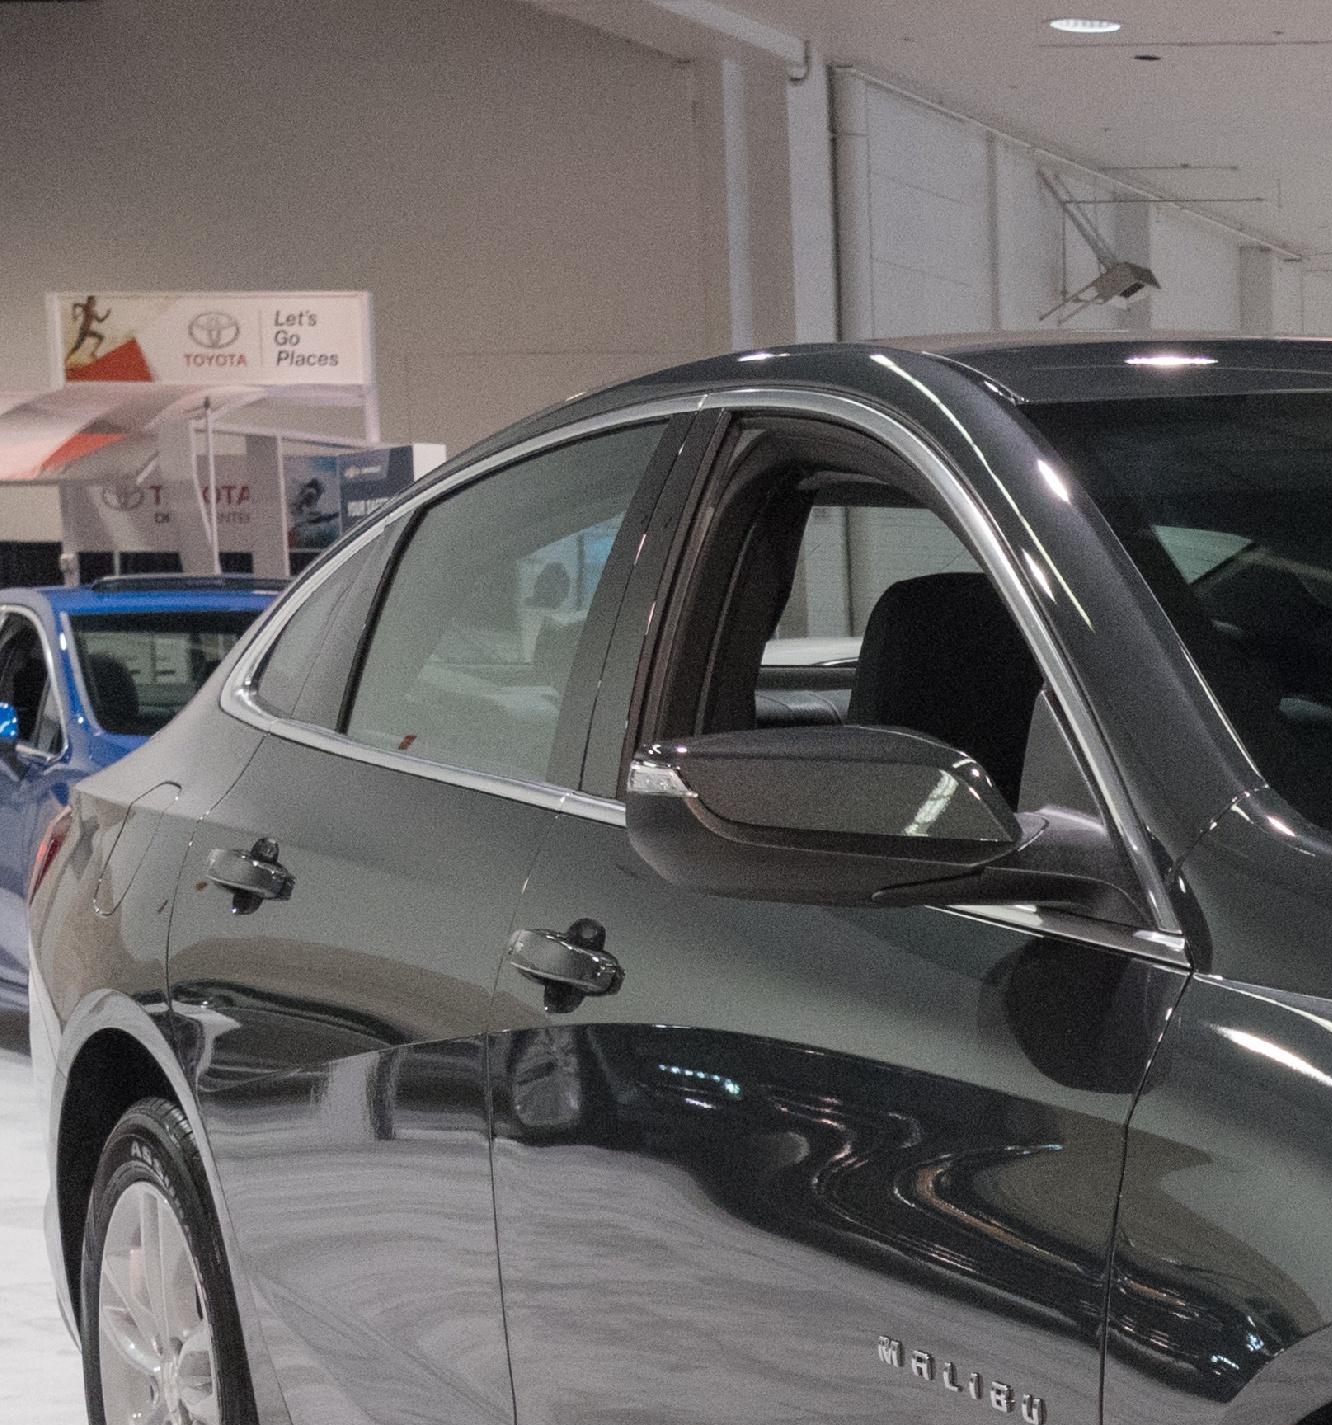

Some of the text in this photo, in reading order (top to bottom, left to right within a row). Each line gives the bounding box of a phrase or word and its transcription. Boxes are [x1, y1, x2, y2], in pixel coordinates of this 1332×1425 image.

[273, 310, 317, 327] Let's
[273, 331, 300, 348] Go
[184, 354, 248, 367] TOYOTA
[276, 351, 339, 367] Places
[878, 1335, 1047, 1425] MALIBU
